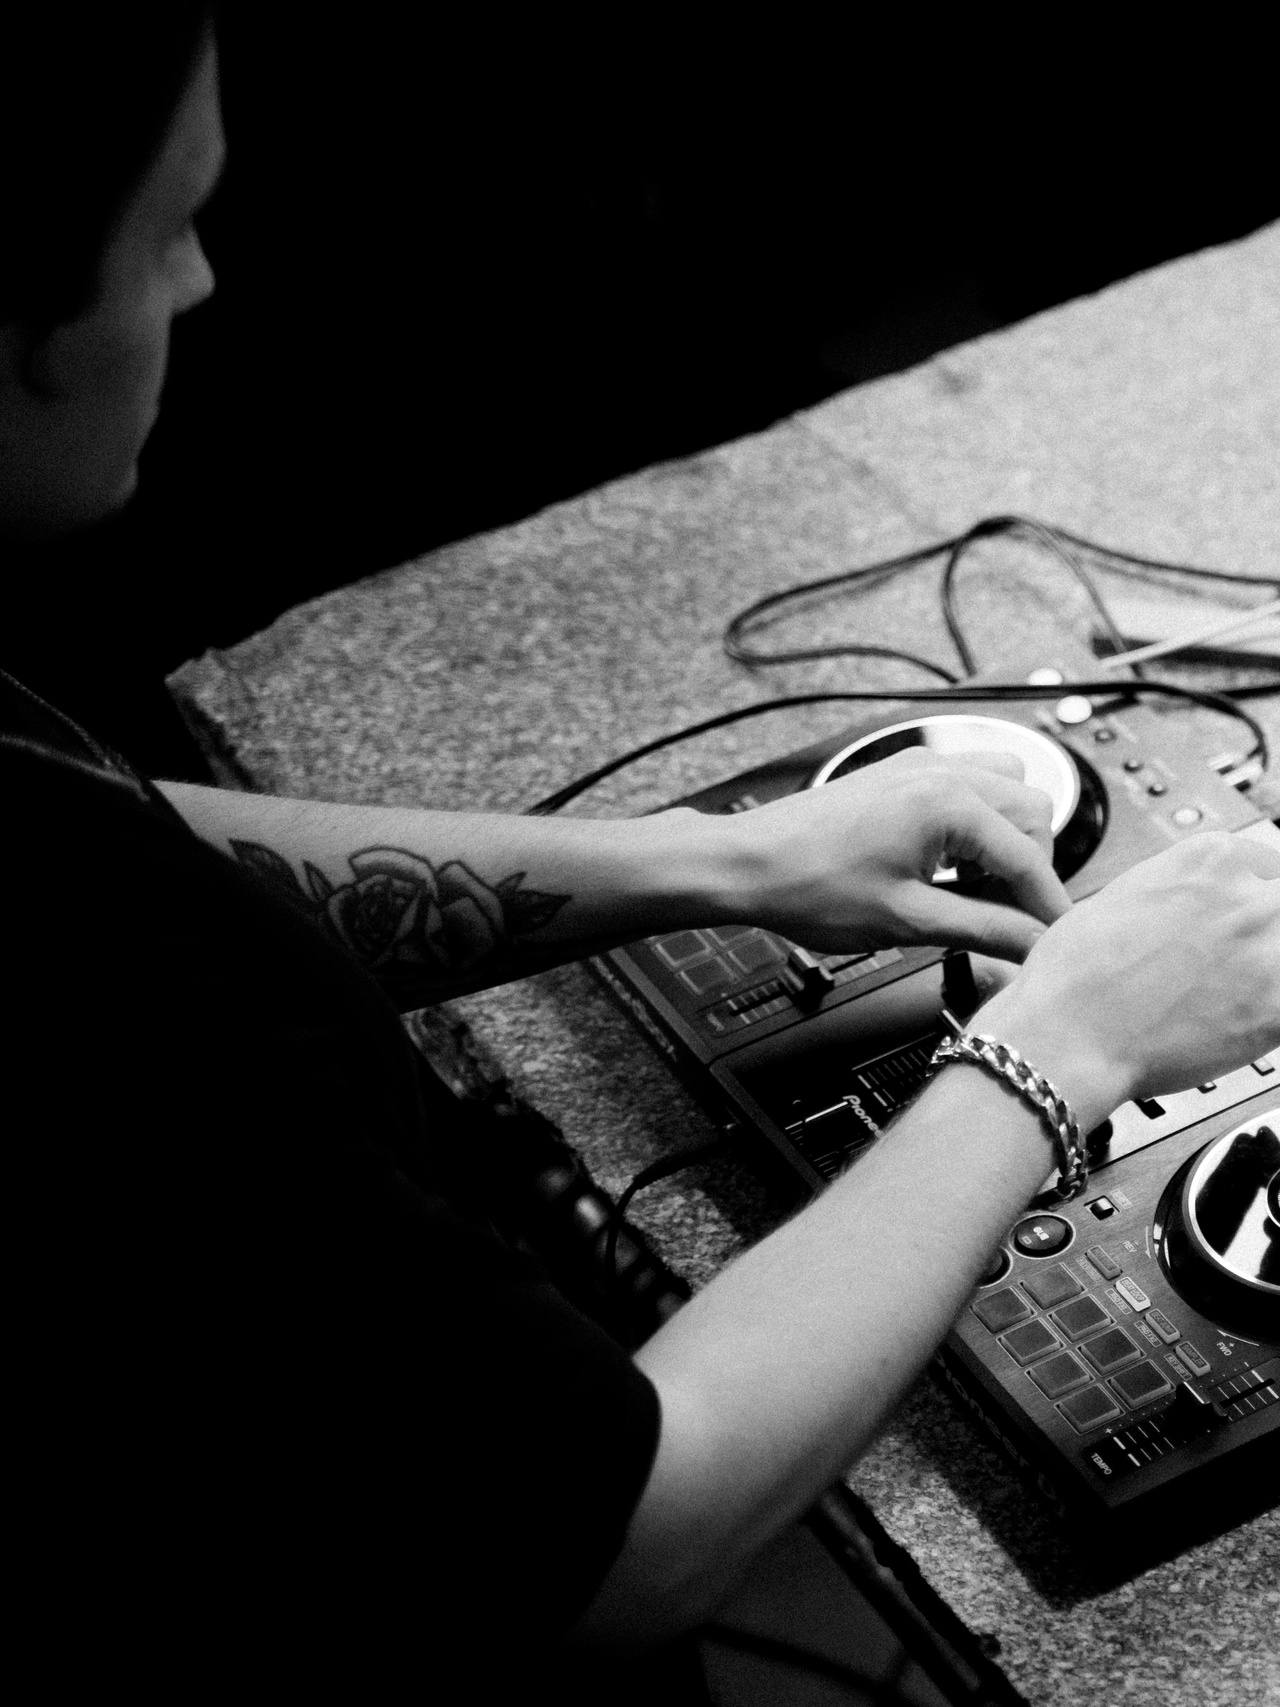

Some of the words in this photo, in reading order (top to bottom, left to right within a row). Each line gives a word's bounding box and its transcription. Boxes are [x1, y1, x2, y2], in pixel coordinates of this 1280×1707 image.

[842, 1095, 885, 1138] Pionee
[1032, 1226, 1049, 1241] CUE
[1122, 1241, 1137, 1252] REV
[1121, 1279, 1136, 1291] BEAT
[1181, 1344, 1204, 1366] SAMPLER
[1217, 1342, 1232, 1356] FWD
[1091, 1453, 1112, 1475] TEMPO
